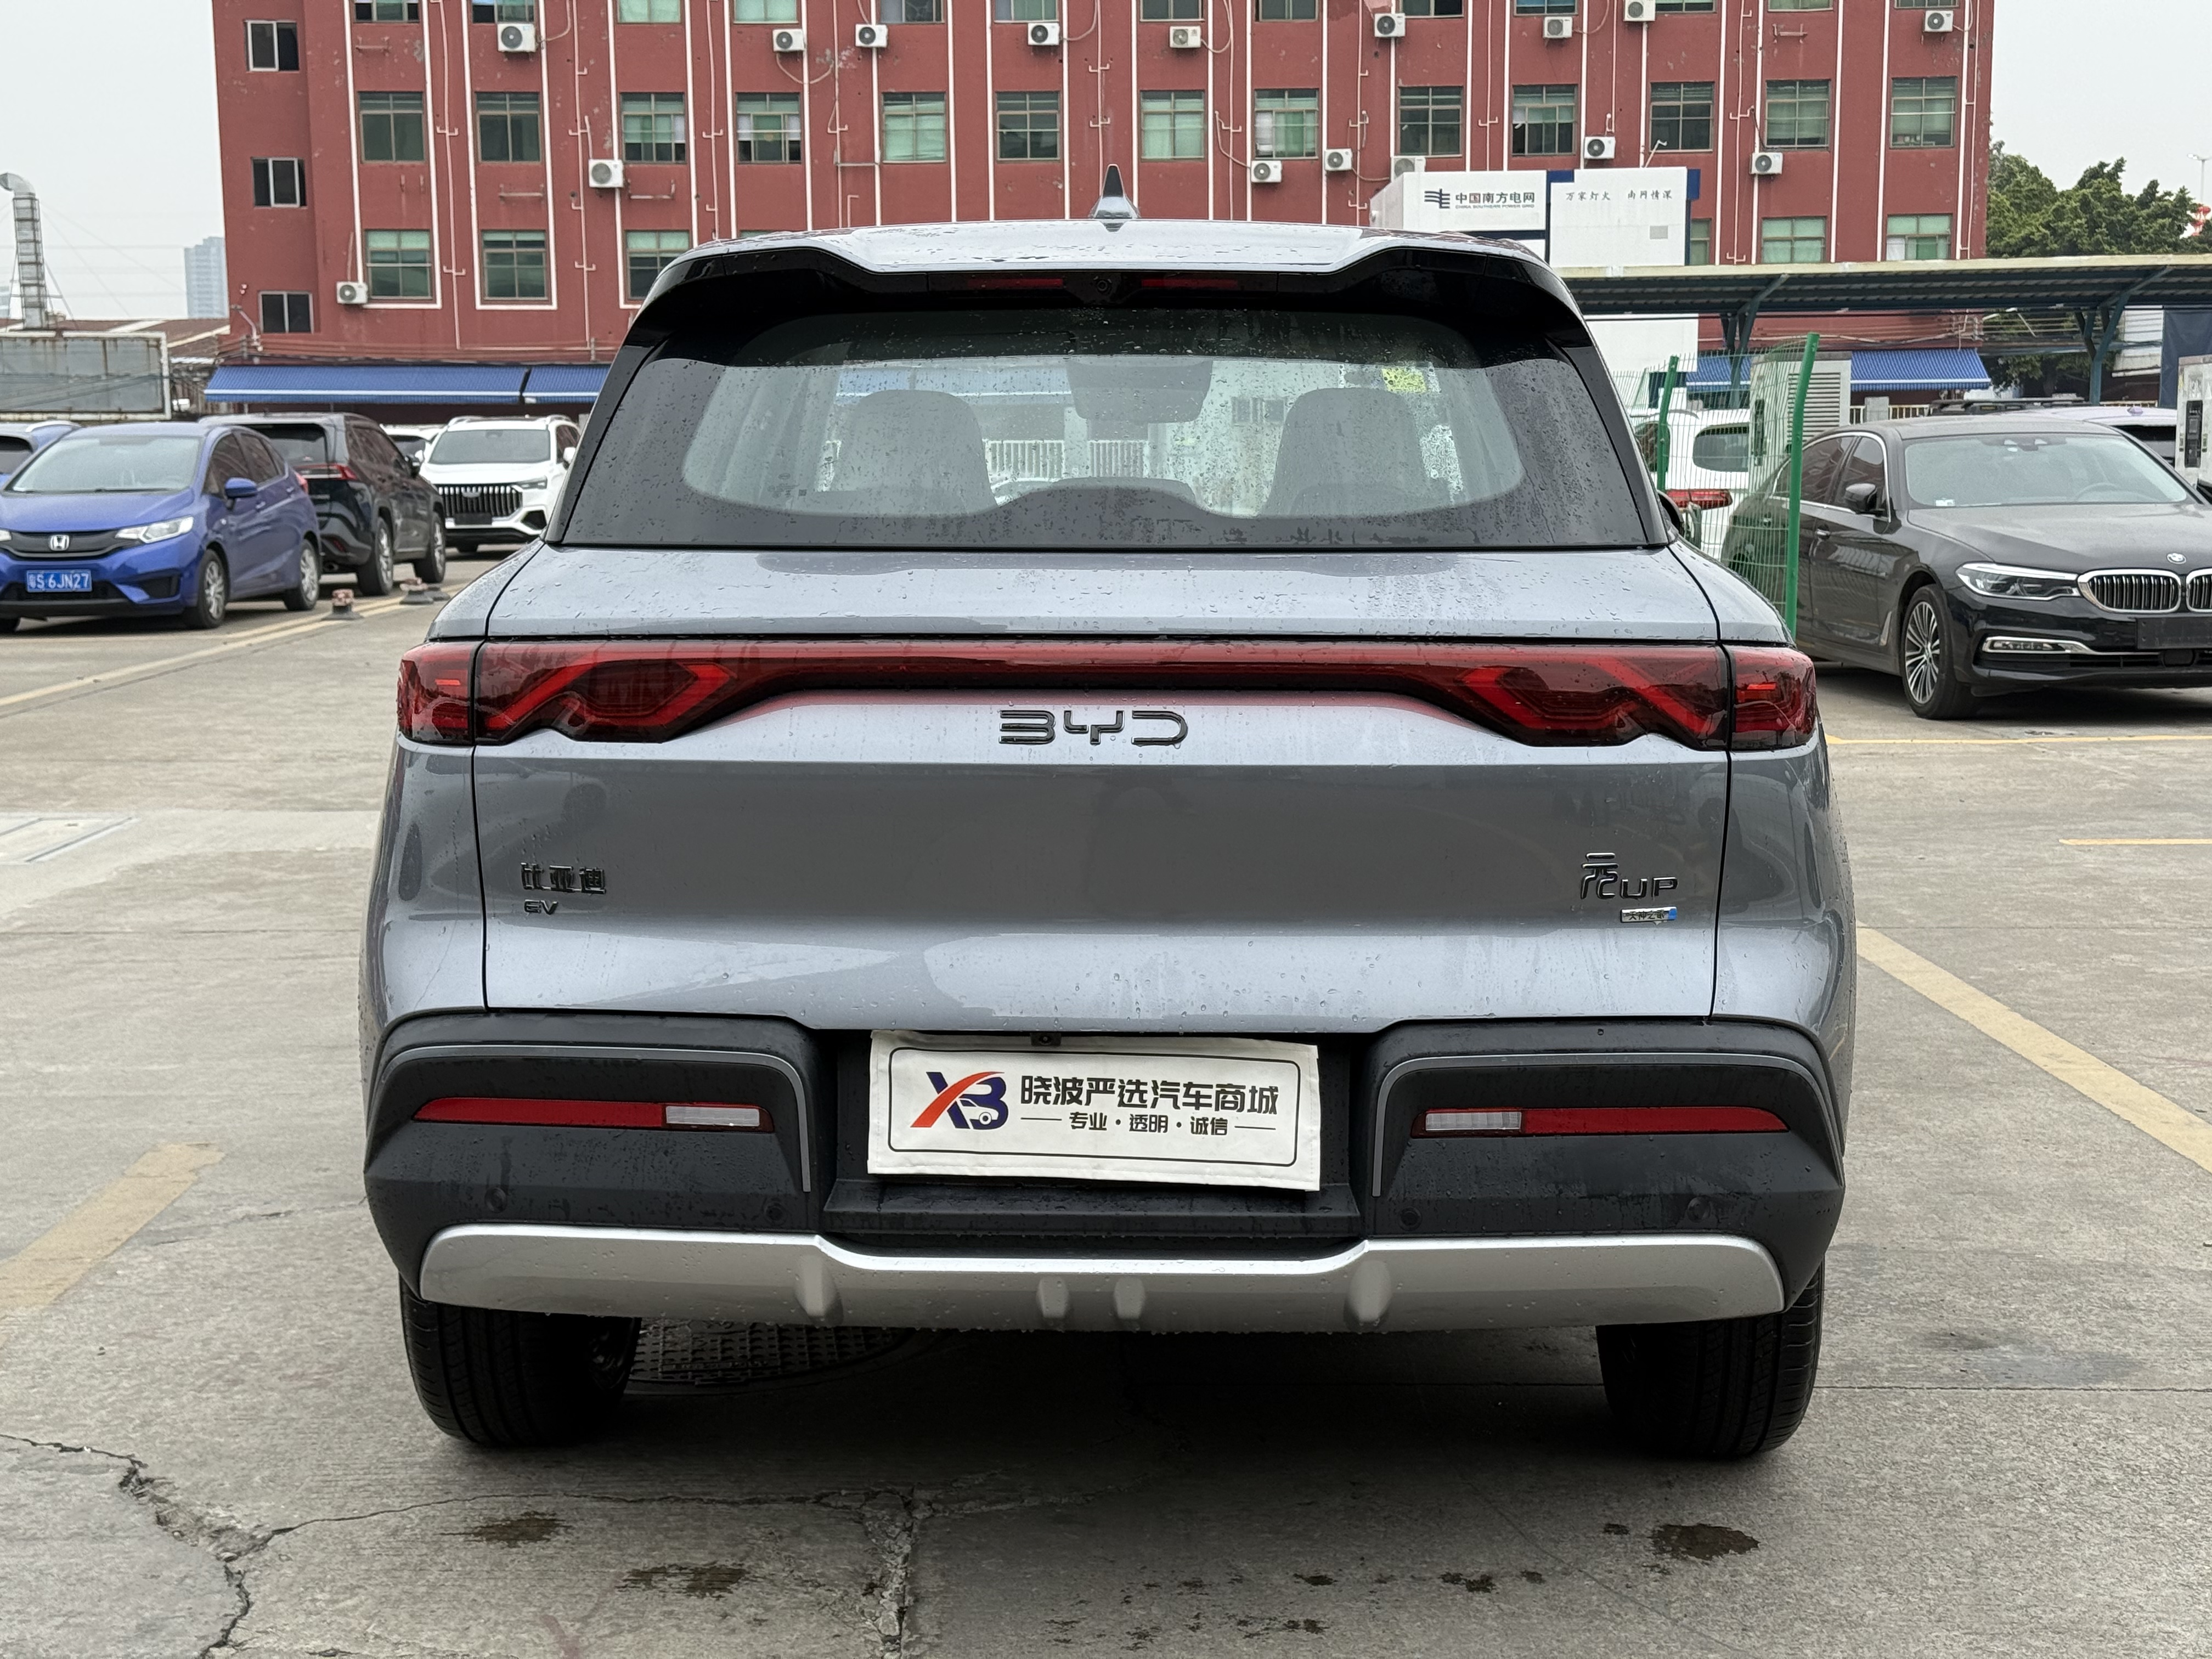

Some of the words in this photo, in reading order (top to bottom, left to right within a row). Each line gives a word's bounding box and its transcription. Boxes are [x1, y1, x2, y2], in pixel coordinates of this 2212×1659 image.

[1455, 191, 1535, 204] 中国南方电网
[1566, 190, 1610, 201] 万家灯火
[999, 709, 1188, 745] BYD
[521, 862, 606, 894] 比亚迪
[524, 899, 558, 915] EV
[1020, 1075, 1278, 1115] 晓波严选汽车商城
